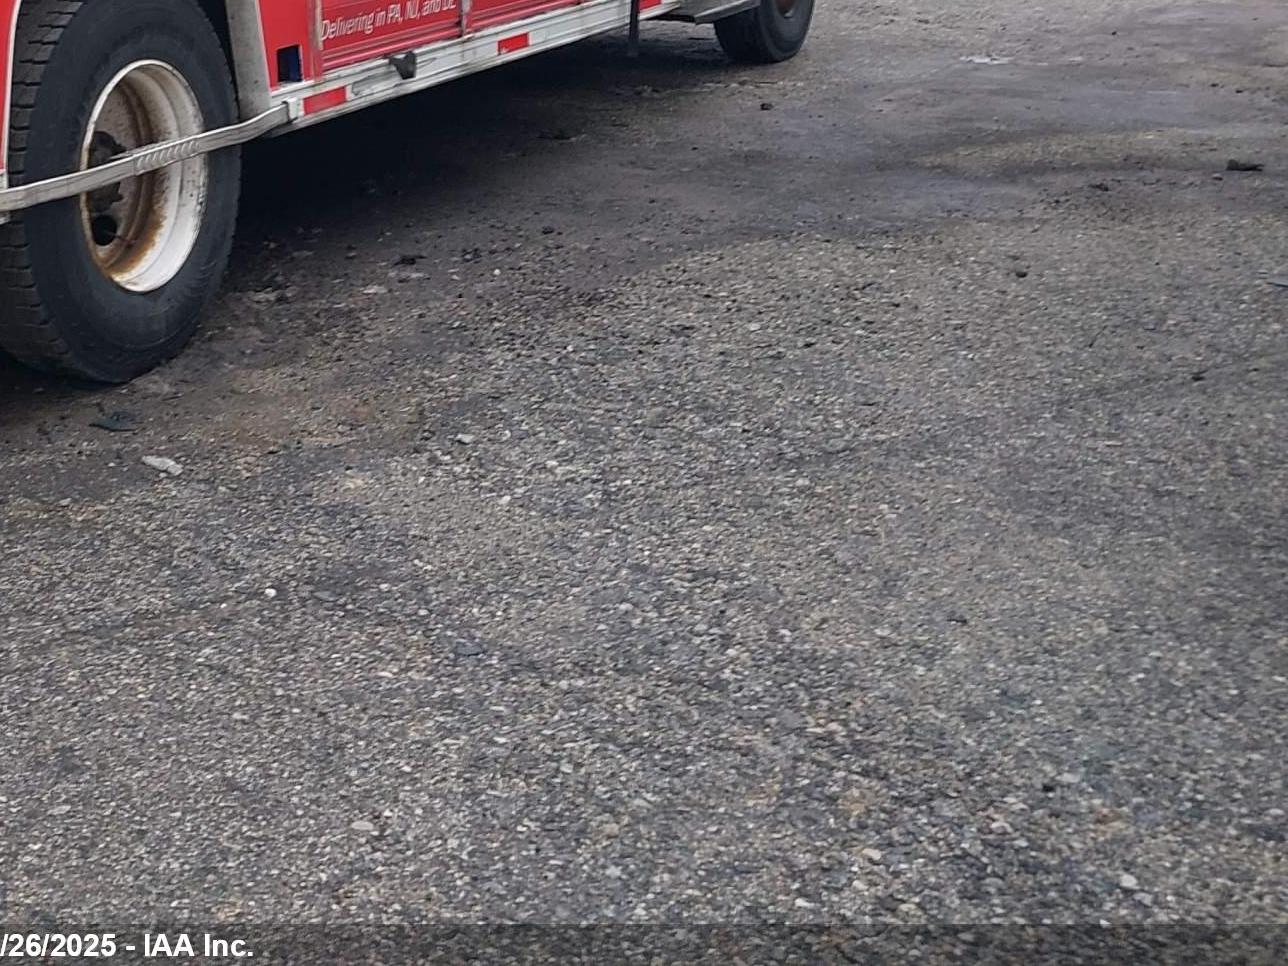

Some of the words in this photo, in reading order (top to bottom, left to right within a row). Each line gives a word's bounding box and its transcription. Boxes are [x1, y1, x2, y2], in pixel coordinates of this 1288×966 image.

[320, 12, 374, 41] Delivering
[375, 8, 386, 27] in
[387, 2, 403, 24] PA,
